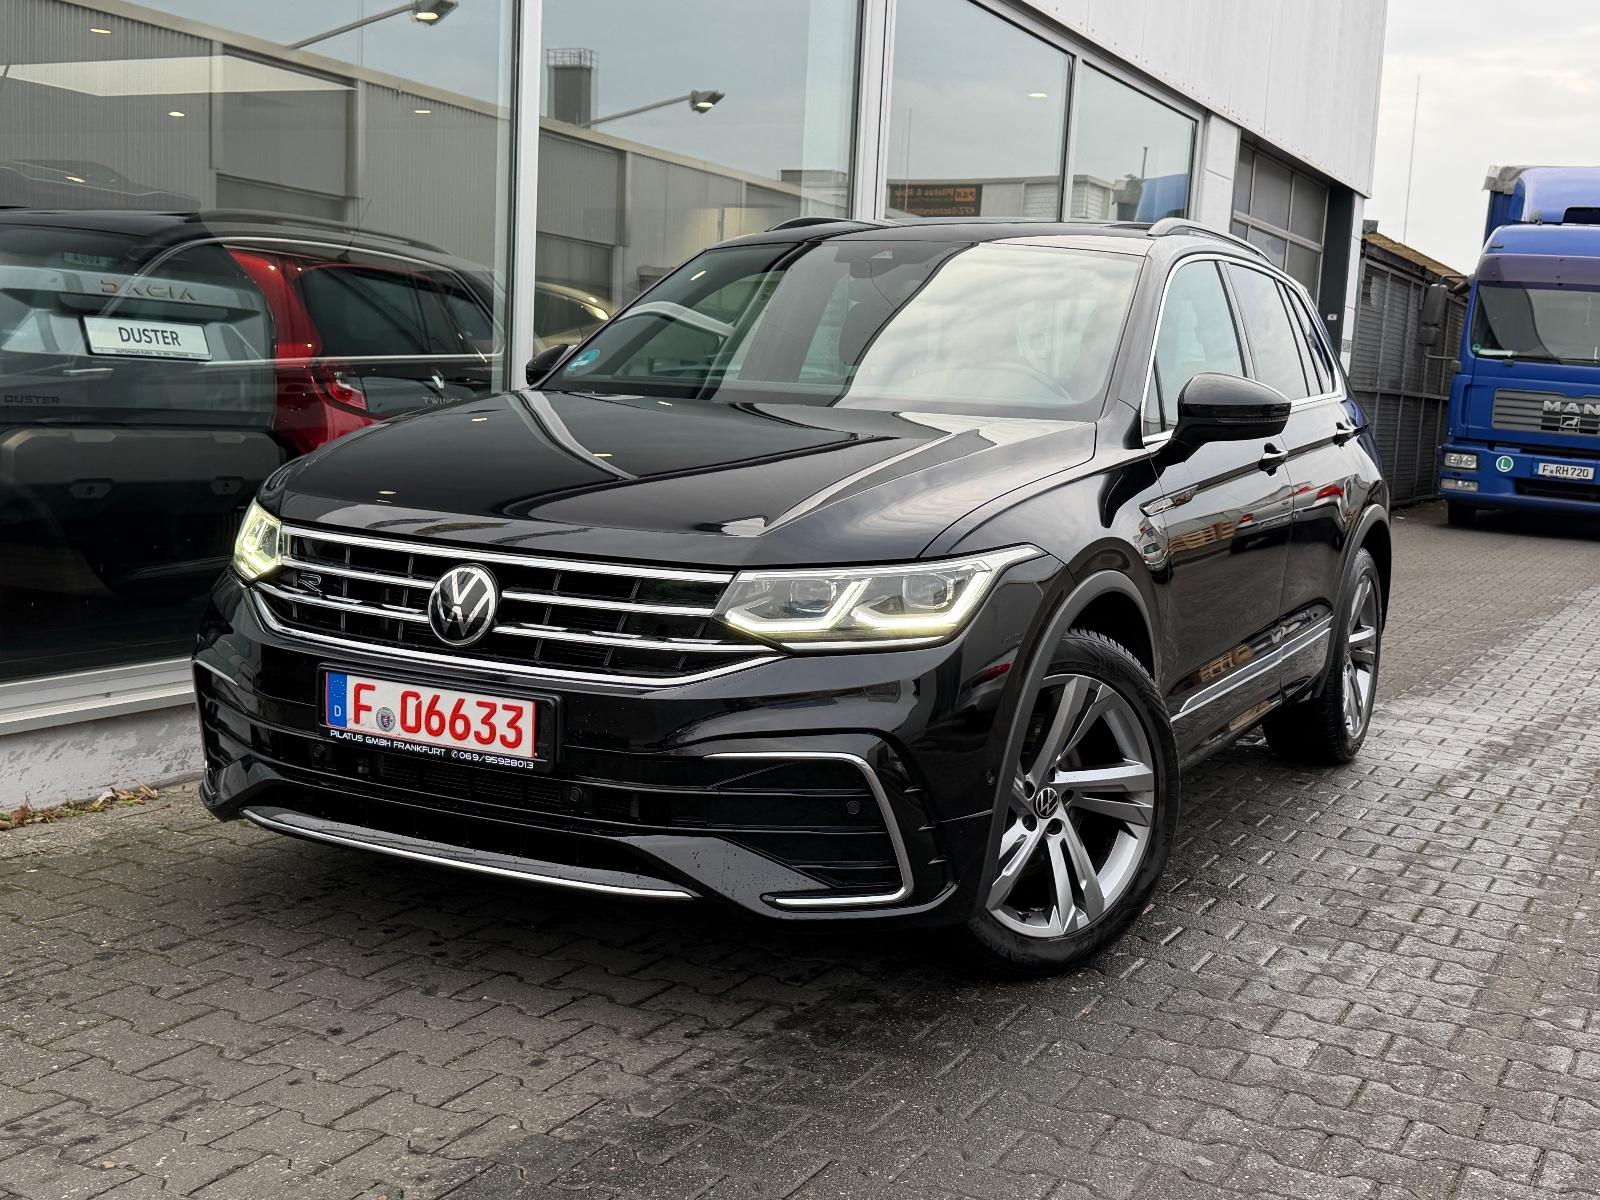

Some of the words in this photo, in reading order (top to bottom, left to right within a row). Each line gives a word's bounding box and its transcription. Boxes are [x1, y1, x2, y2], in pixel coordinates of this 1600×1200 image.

[100, 278, 196, 301] DACIA
[118, 326, 181, 346] DUSTER
[4, 394, 60, 405] DUSTER
[1542, 400, 1600, 416] MAN
[334, 704, 342, 717] D
[353, 682, 376, 725] F
[400, 690, 524, 750] 06633
[330, 729, 364, 743] PILATUS
[365, 736, 391, 748] GMBH
[393, 740, 446, 757] FRANKFURT
